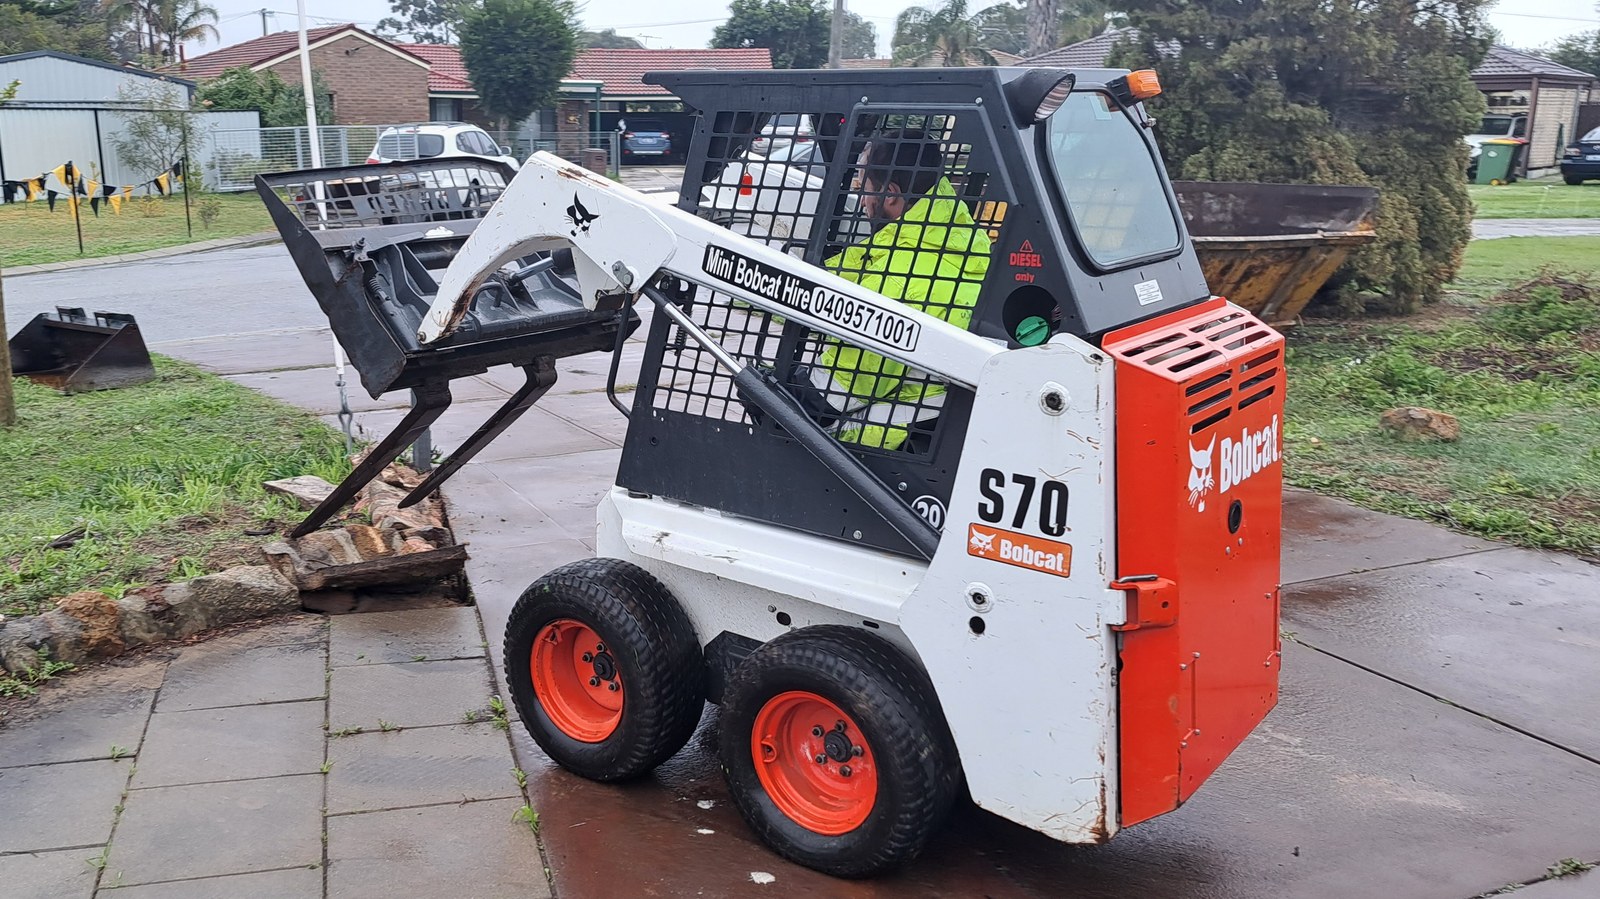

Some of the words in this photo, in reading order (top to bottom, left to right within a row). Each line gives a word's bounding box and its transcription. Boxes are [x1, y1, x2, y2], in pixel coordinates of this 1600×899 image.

[1009, 253, 1042, 267] DIESEL
[1015, 272, 1035, 283] only
[706, 246, 735, 280] Mini
[734, 258, 782, 300] Bobcat
[782, 276, 810, 310] Hire
[814, 289, 915, 348] 0409571001
[1220, 413, 1279, 494] Bobcat
[978, 467, 1069, 537] S70
[1000, 538, 1066, 573] Bobcat
